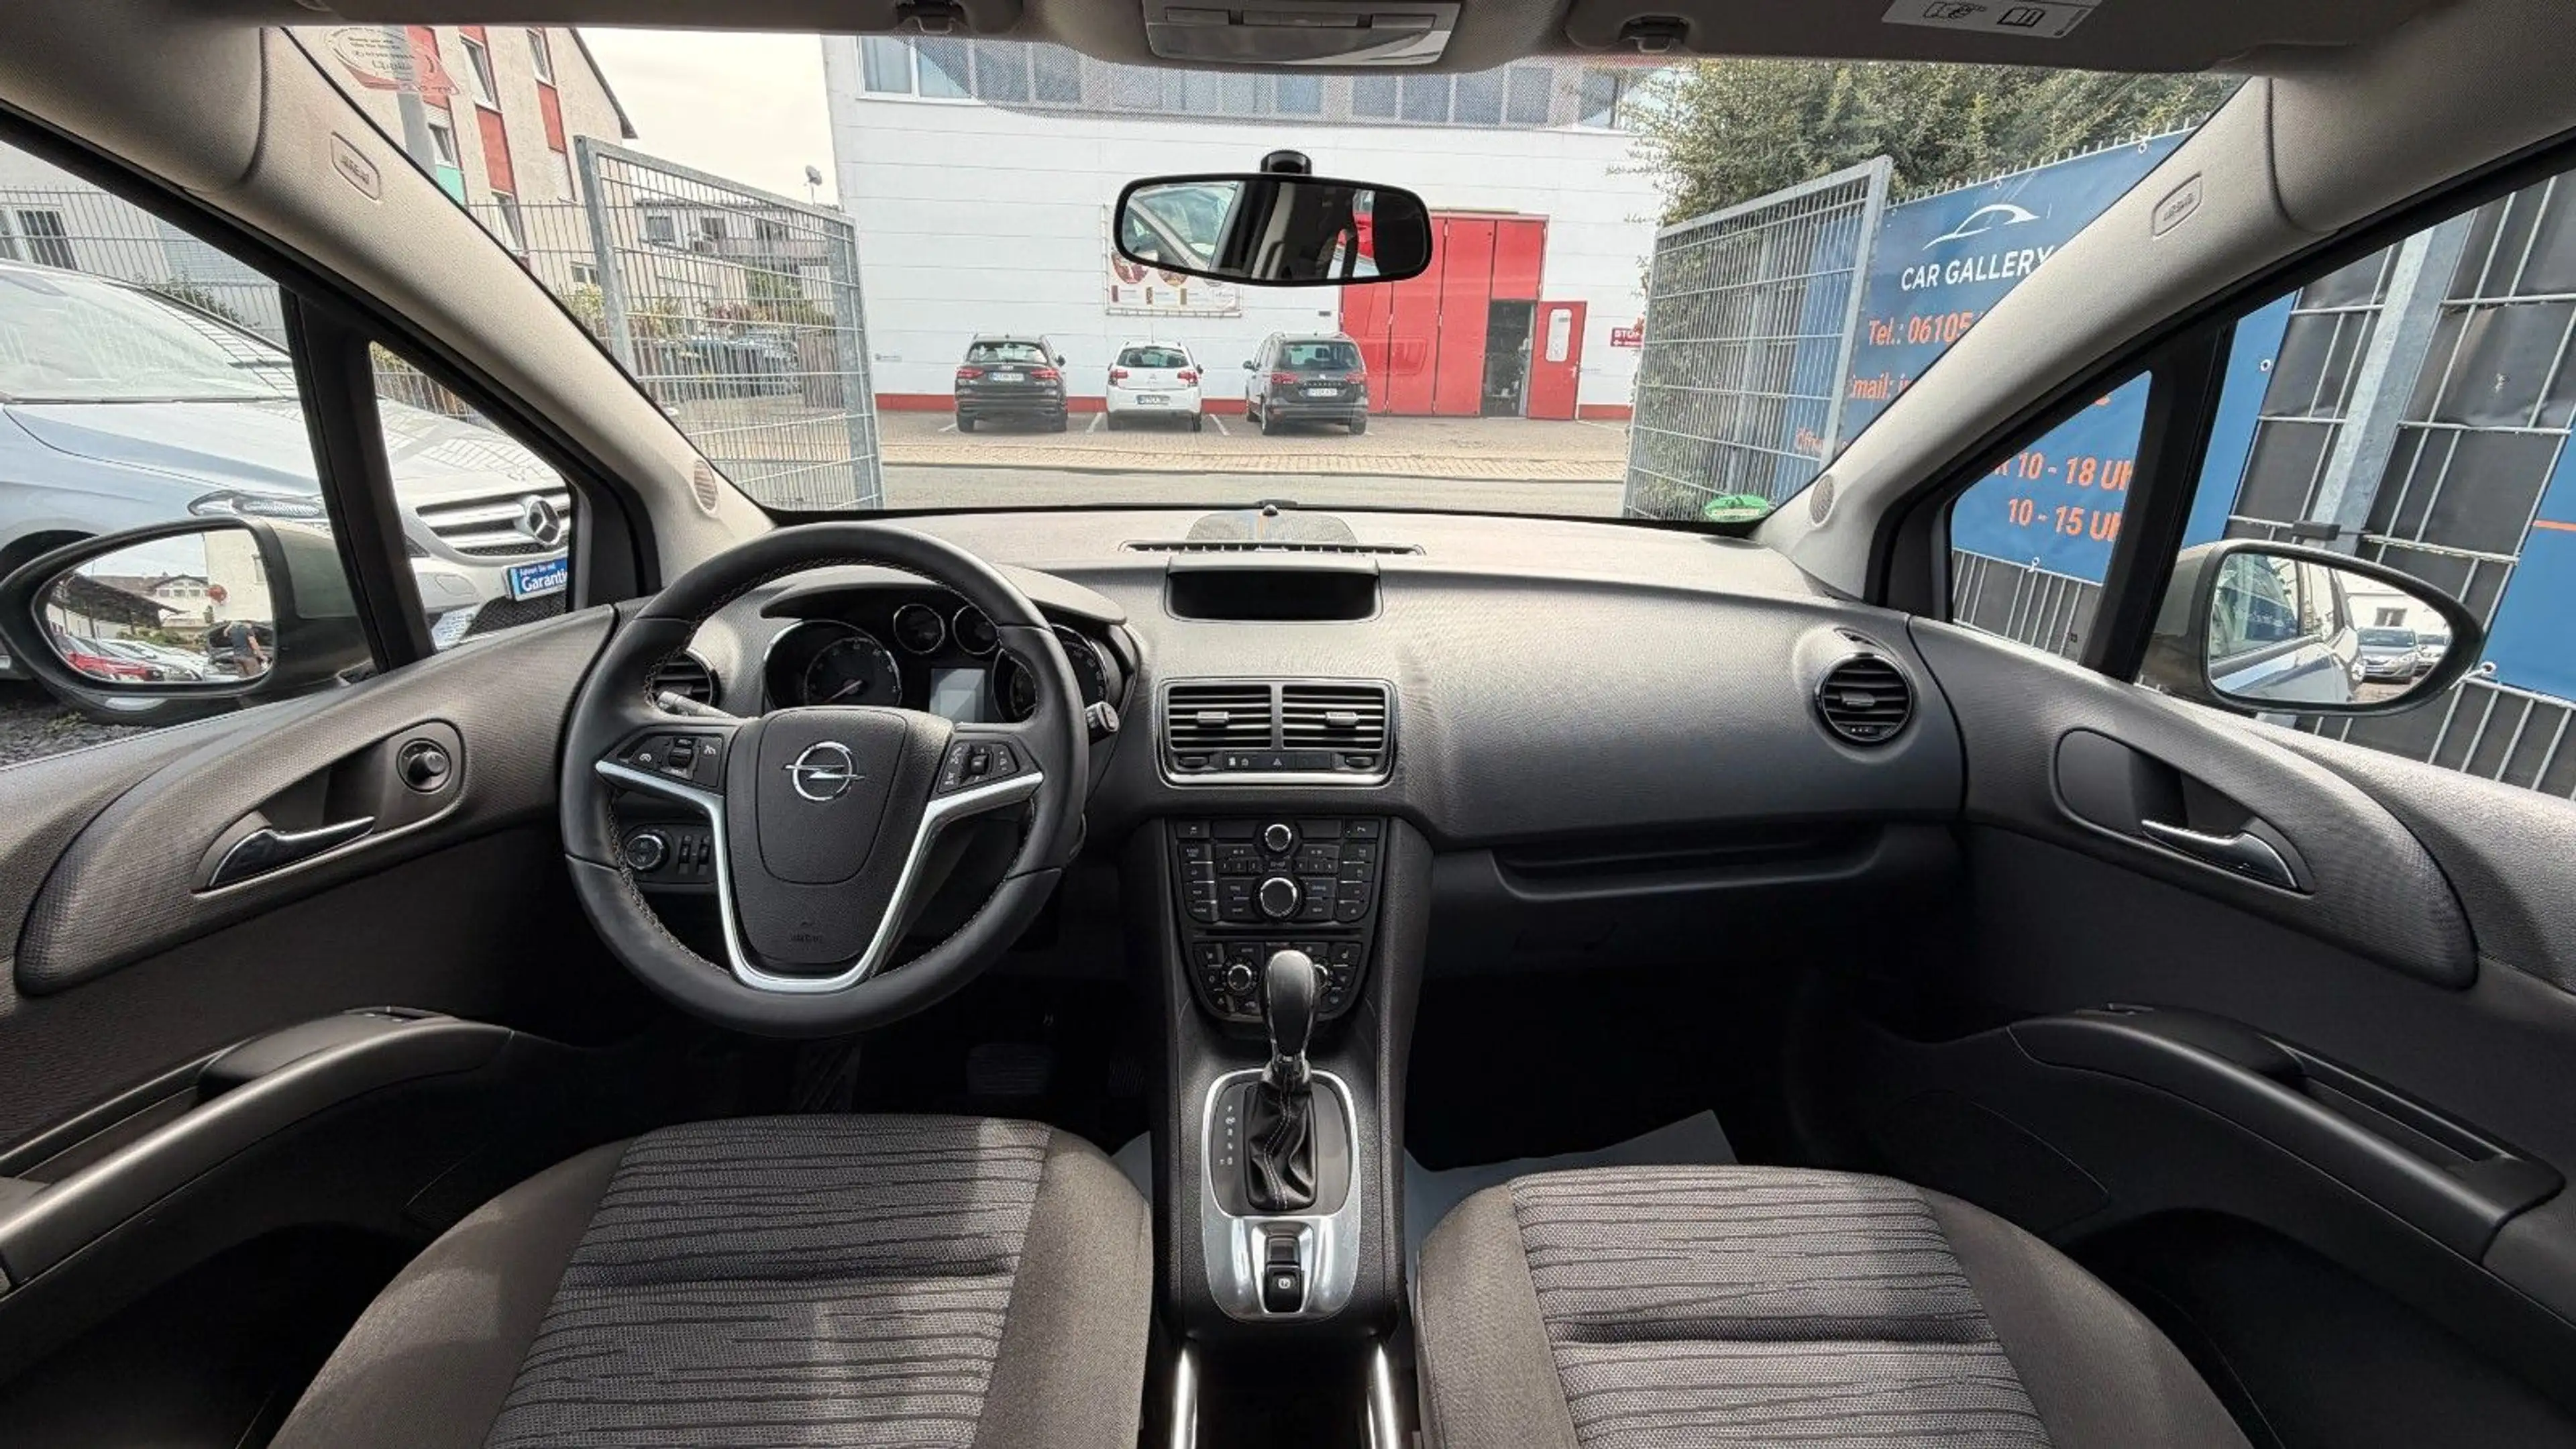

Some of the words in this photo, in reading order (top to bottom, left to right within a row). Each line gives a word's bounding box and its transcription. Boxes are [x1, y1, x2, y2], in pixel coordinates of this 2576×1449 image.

[1901, 264, 1940, 291] CAR
[1945, 246, 2055, 285] GALLERY
[1869, 316, 1904, 345] Tel.:
[1908, 310, 1974, 344] 06105
[1849, 372, 1894, 400] mail:
[2018, 452, 2045, 480] 10
[2066, 456, 2097, 486] 18
[2008, 498, 2033, 527] 10
[2055, 505, 2084, 536] 15
